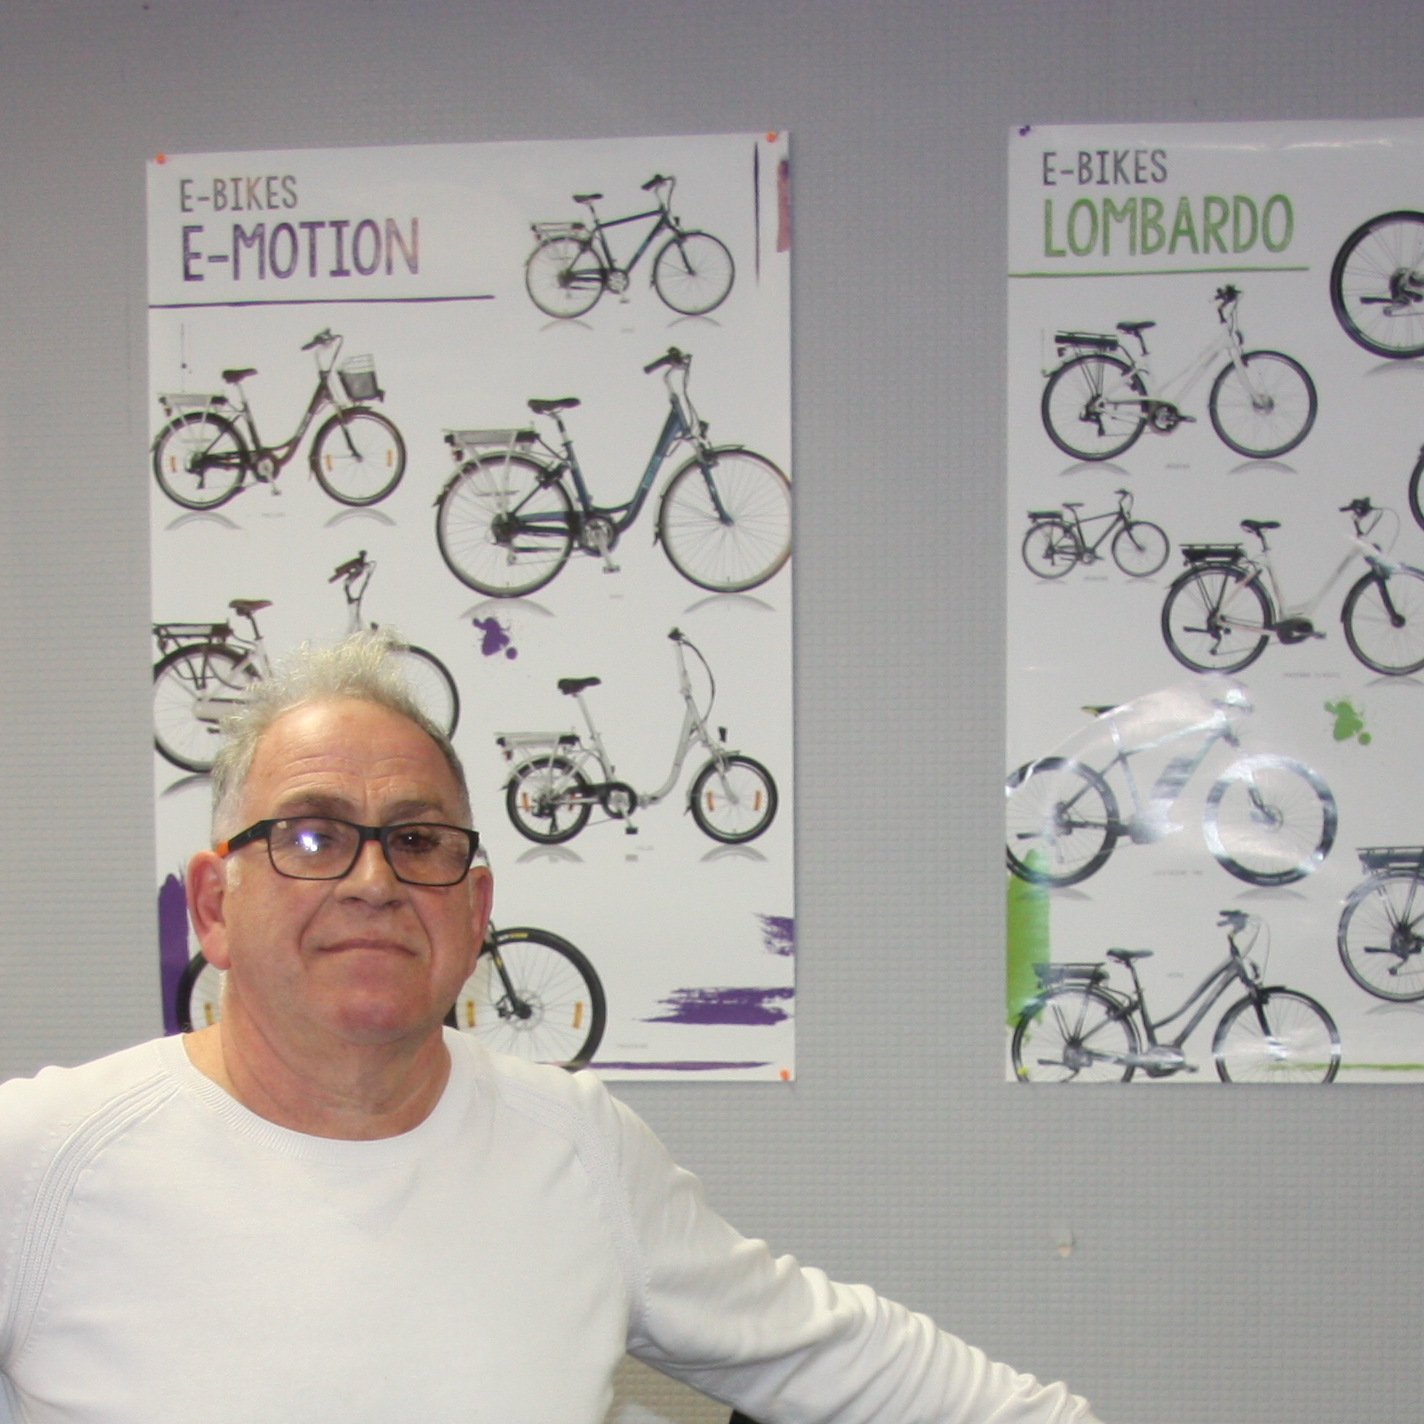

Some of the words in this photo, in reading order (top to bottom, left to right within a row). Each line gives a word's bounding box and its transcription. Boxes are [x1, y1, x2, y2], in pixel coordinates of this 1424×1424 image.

[1042, 148, 1169, 187] E-BIKES
[179, 174, 299, 214] E-BIKES
[182, 216, 421, 283] E-MOTION
[1043, 193, 1296, 258] LOMBARDO
